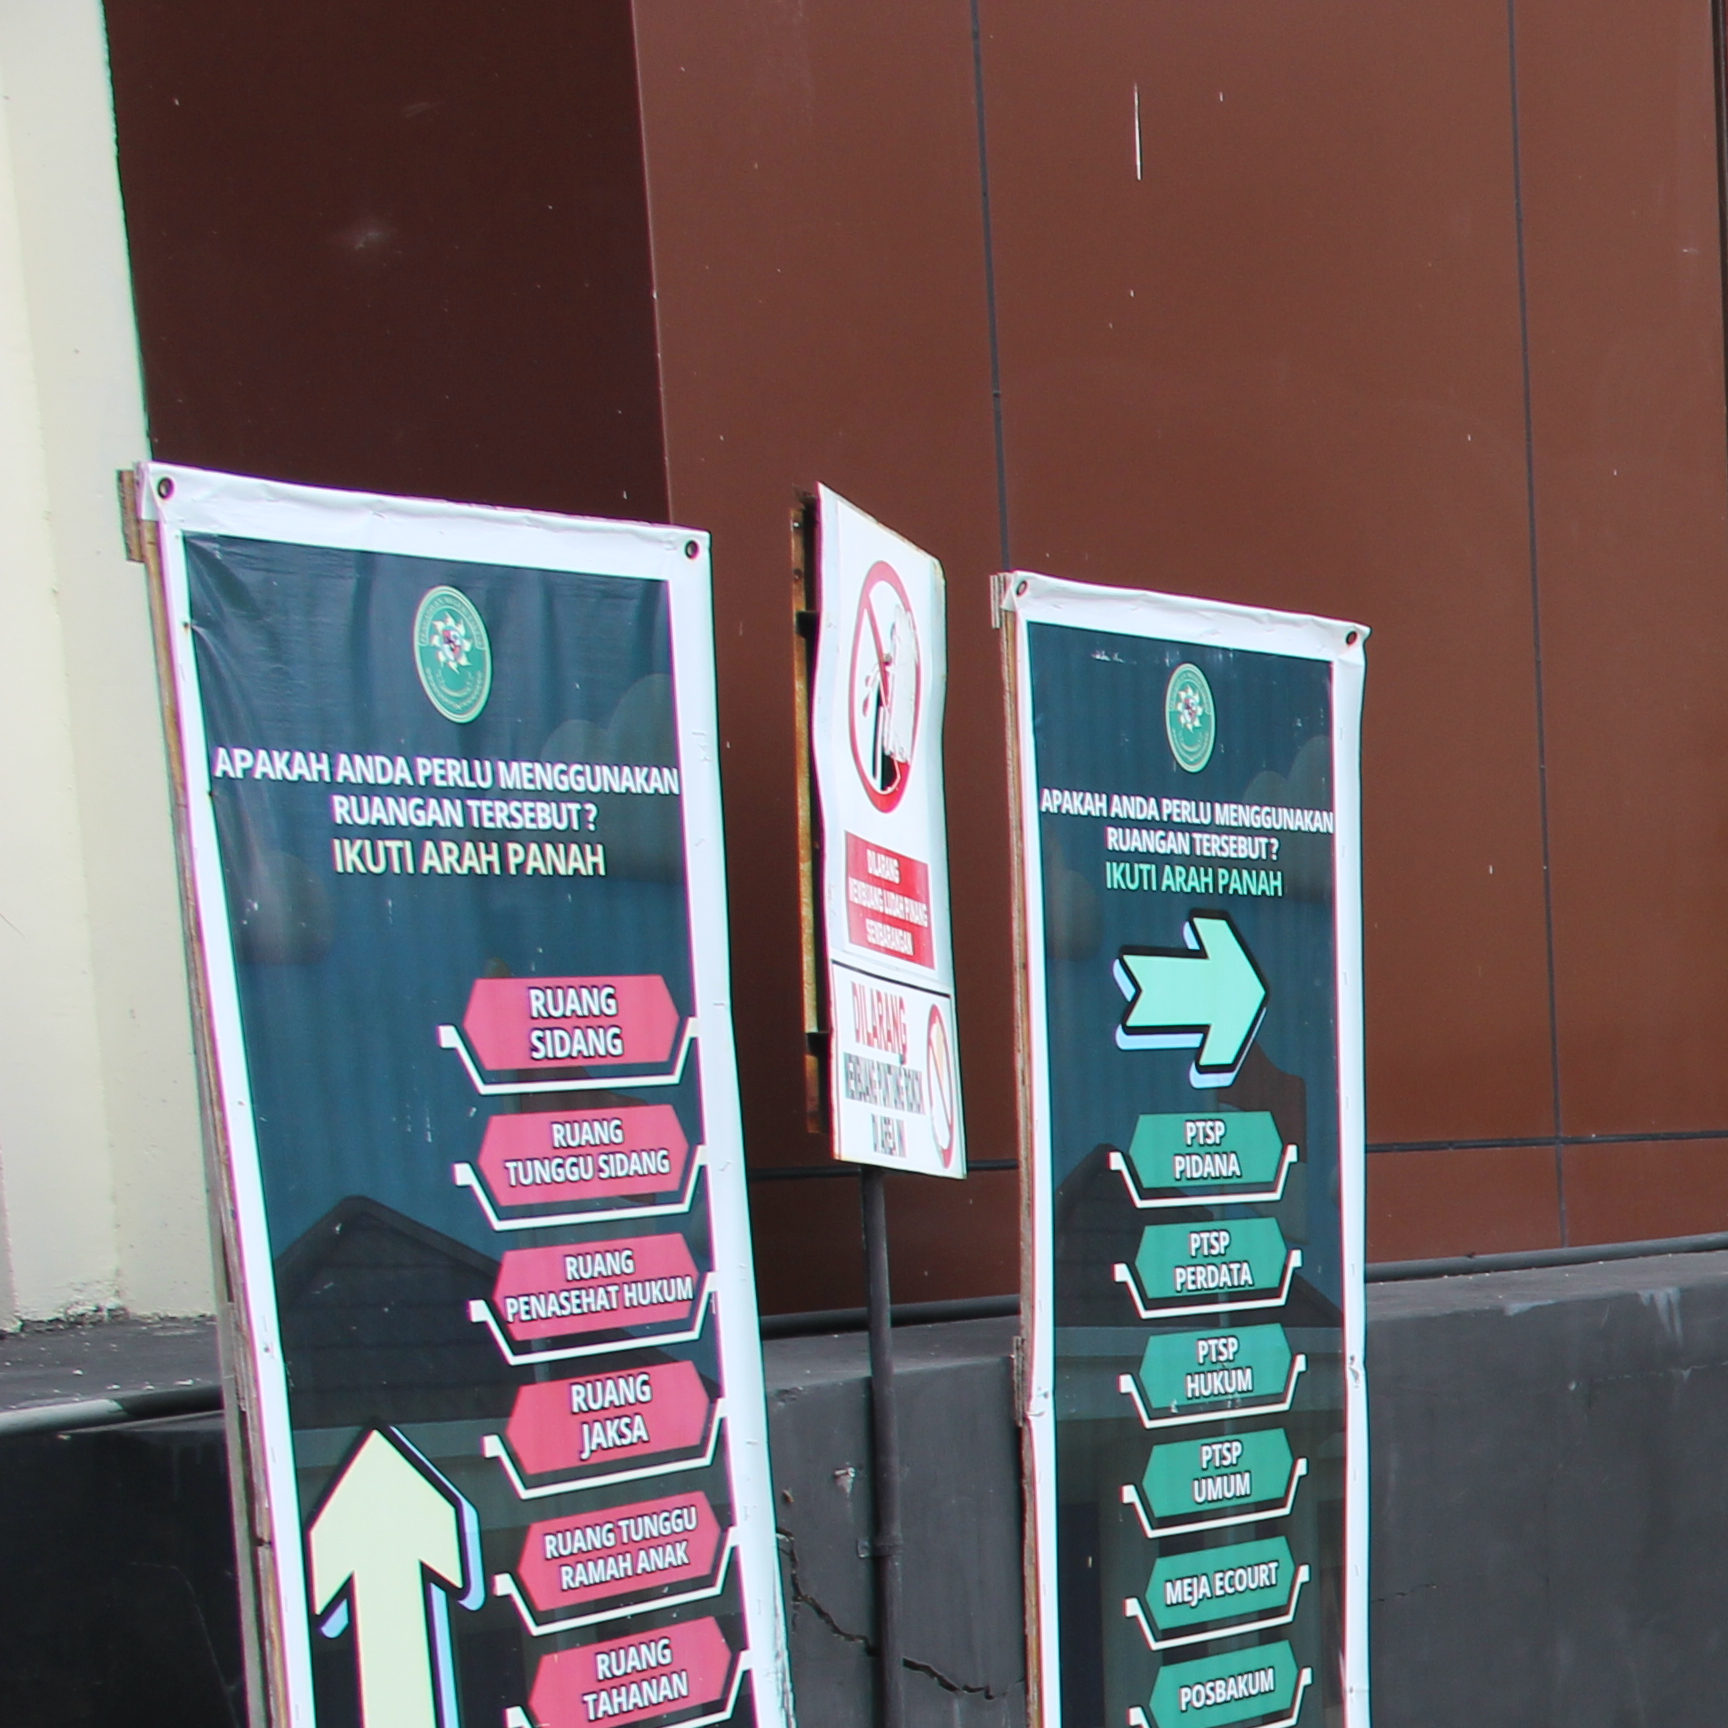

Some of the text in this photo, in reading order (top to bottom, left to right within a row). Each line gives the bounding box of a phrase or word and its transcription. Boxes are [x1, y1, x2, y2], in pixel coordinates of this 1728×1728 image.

[214, 747, 680, 795] APAKAH ANDA PERLU MENGGUNAKAN
[333, 794, 463, 828] RUANGAN
[1041, 788, 1334, 834] APAKAH ANDA PERLU MENGGUNAKAN
[333, 838, 606, 877] IKUTI ARAH PANAH
[1106, 826, 1190, 856] RUANGAN
[1105, 861, 1283, 897] IKUTI ARAH PANAH
[529, 987, 618, 1019] RUANG
[851, 981, 908, 1056] DILARANG
[530, 1027, 624, 1060] SIDANG
[551, 1119, 624, 1148] RUANG
[1185, 1120, 1226, 1146] PTSP
[505, 1150, 671, 1187] TUNGGU SIDANG
[1173, 1152, 1242, 1180] PIDANA
[1189, 1230, 1230, 1257] PTSP
[565, 1250, 635, 1281] RUANG
[1174, 1262, 1253, 1292] PERDATA
[505, 1276, 694, 1322] PENASEHAT HUKUM
[1197, 1336, 1239, 1364] PTSP
[571, 1373, 652, 1413] RUANG
[1185, 1367, 1253, 1398] HUKUM
[580, 1414, 649, 1460] JAKSA
[1201, 1441, 1243, 1468] PTSP
[1193, 1472, 1251, 1503] UMUM
[544, 1506, 698, 1560] RUANG TUNGGU
[560, 1541, 689, 1591] RAMAH ANAK
[1164, 1562, 1279, 1607] MEJA ECOURT
[596, 1637, 672, 1681] RUANG
[583, 1669, 689, 1721] TAHANAN
[1179, 1668, 1275, 1712] POSBAKUM
